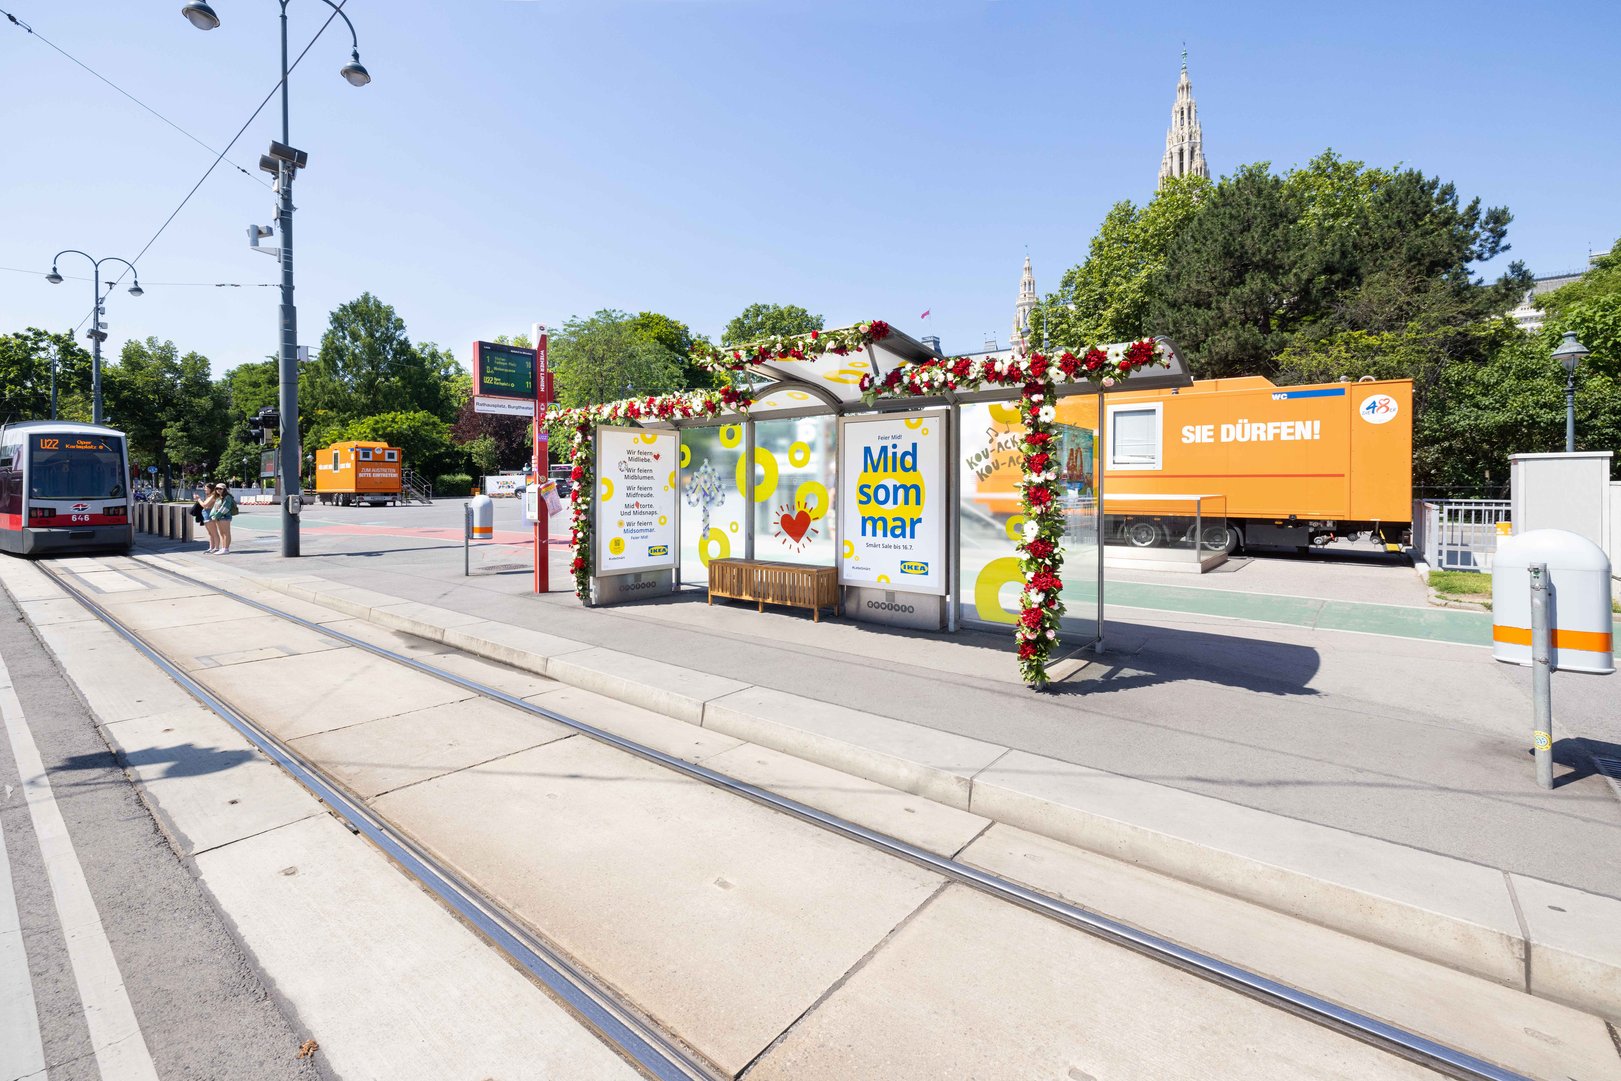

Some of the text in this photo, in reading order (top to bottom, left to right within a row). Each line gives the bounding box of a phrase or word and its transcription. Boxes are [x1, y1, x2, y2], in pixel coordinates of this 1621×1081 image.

[1181, 418, 1321, 443] SIE DÜRFEN!
[40, 438, 59, 449] U22
[966, 435, 1018, 470] KOU-ACK
[863, 442, 918, 473] Mid
[976, 454, 1023, 482] KOU-AC
[858, 483, 921, 506] som
[71, 514, 90, 522] 646
[861, 515, 922, 539] mar
